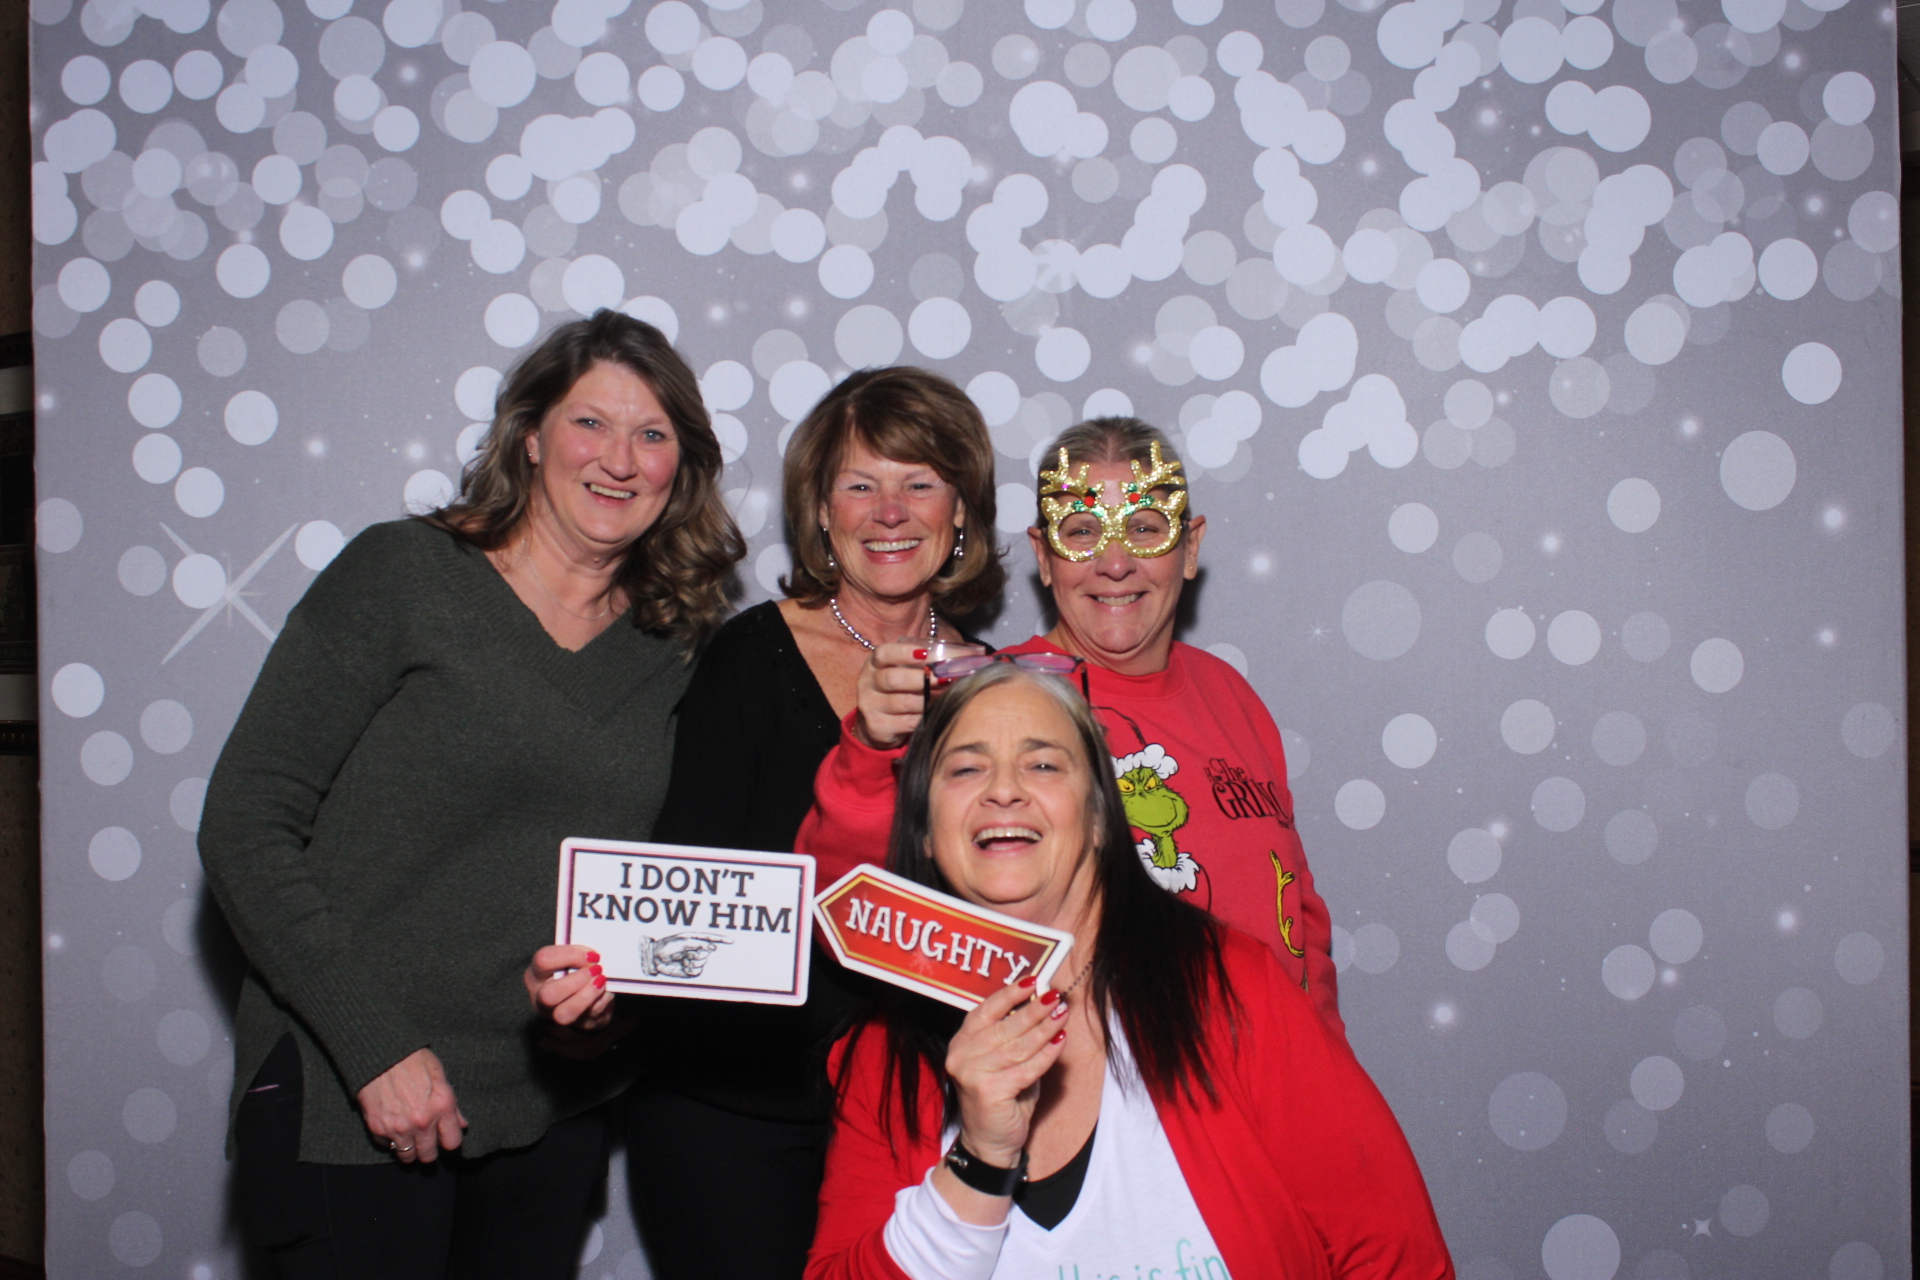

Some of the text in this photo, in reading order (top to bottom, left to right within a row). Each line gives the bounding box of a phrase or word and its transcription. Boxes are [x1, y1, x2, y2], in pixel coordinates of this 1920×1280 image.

[1209, 757, 1248, 782] The
[620, 862, 755, 898] I DON'T
[577, 891, 792, 934] KNOW HIM
[844, 897, 1031, 986] NAUGHTY
